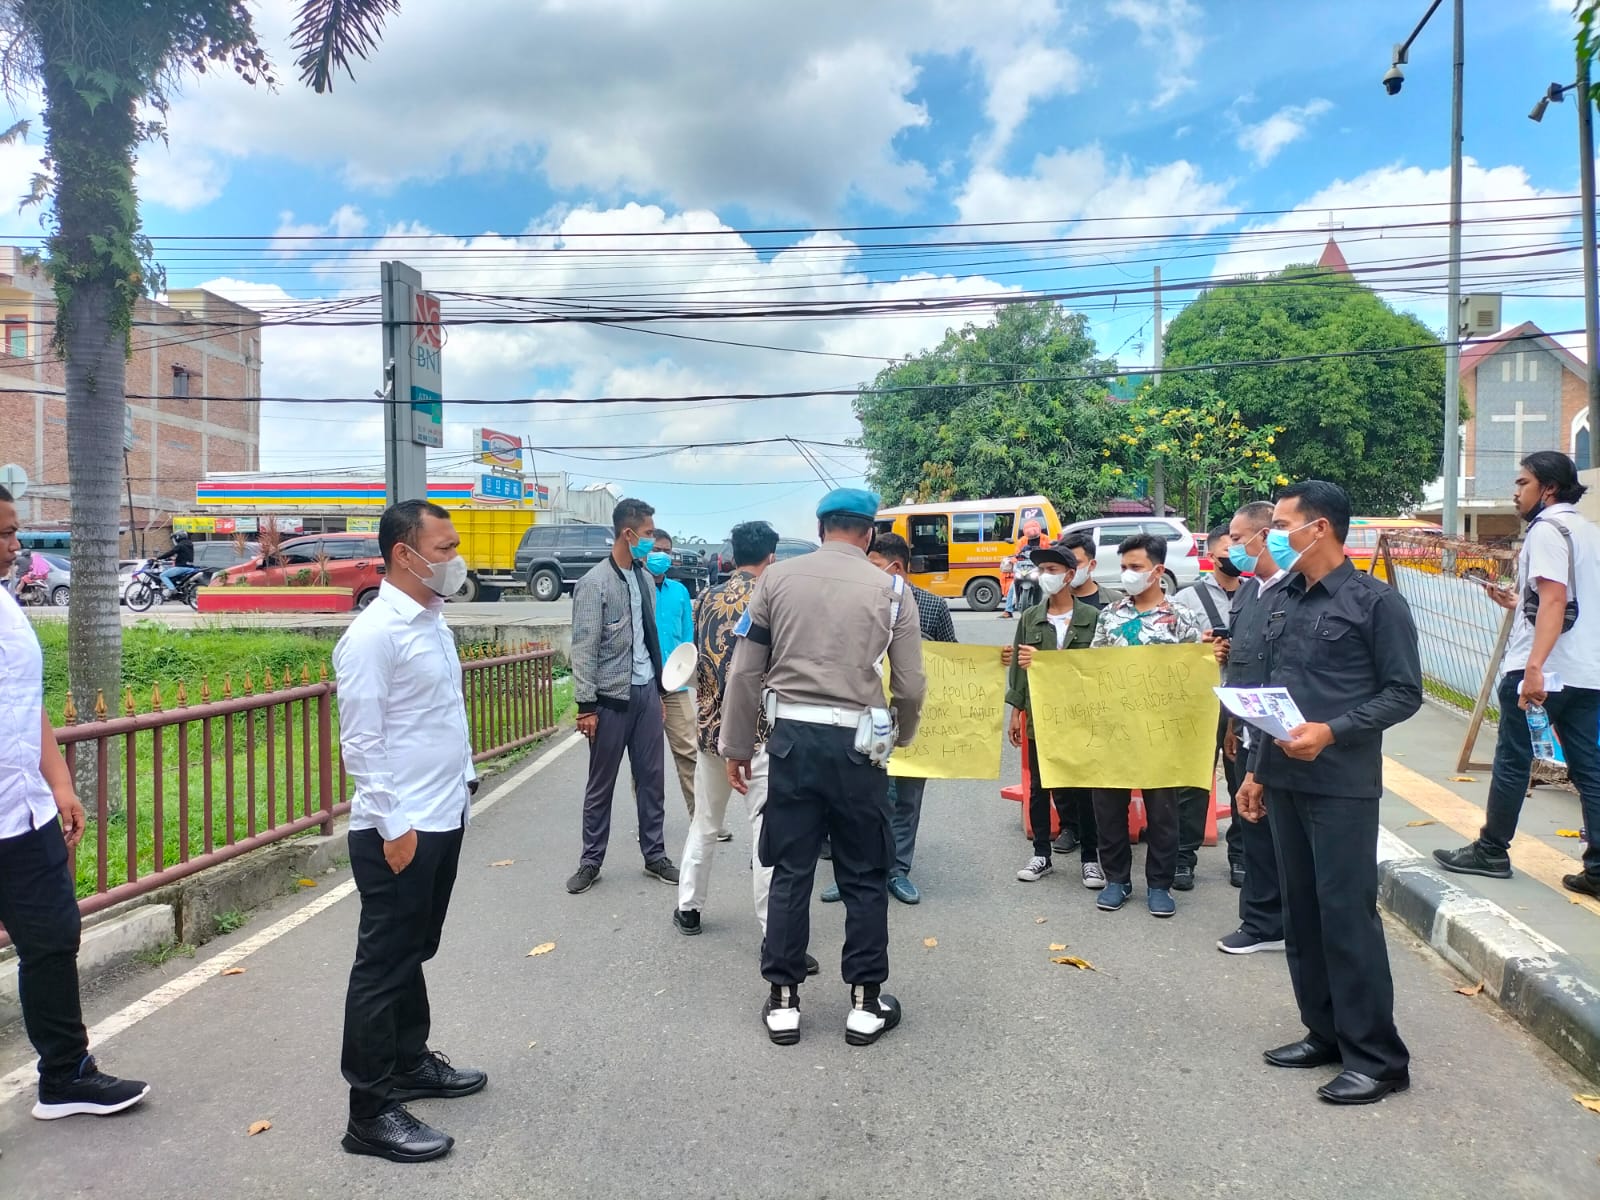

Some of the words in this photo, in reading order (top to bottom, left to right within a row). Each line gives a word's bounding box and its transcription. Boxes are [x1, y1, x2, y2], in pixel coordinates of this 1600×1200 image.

[417, 345, 440, 375] BNI
[1025, 509, 1038, 519] 07
[924, 655, 977, 679] MINTA
[1067, 661, 1191, 697] TANGKAP
[1120, 689, 1191, 712] BENDERA
[922, 706, 952, 721] NDAK
[919, 725, 960, 738] BARAN
[1146, 717, 1199, 747] HTI
[942, 743, 973, 759] HTI
